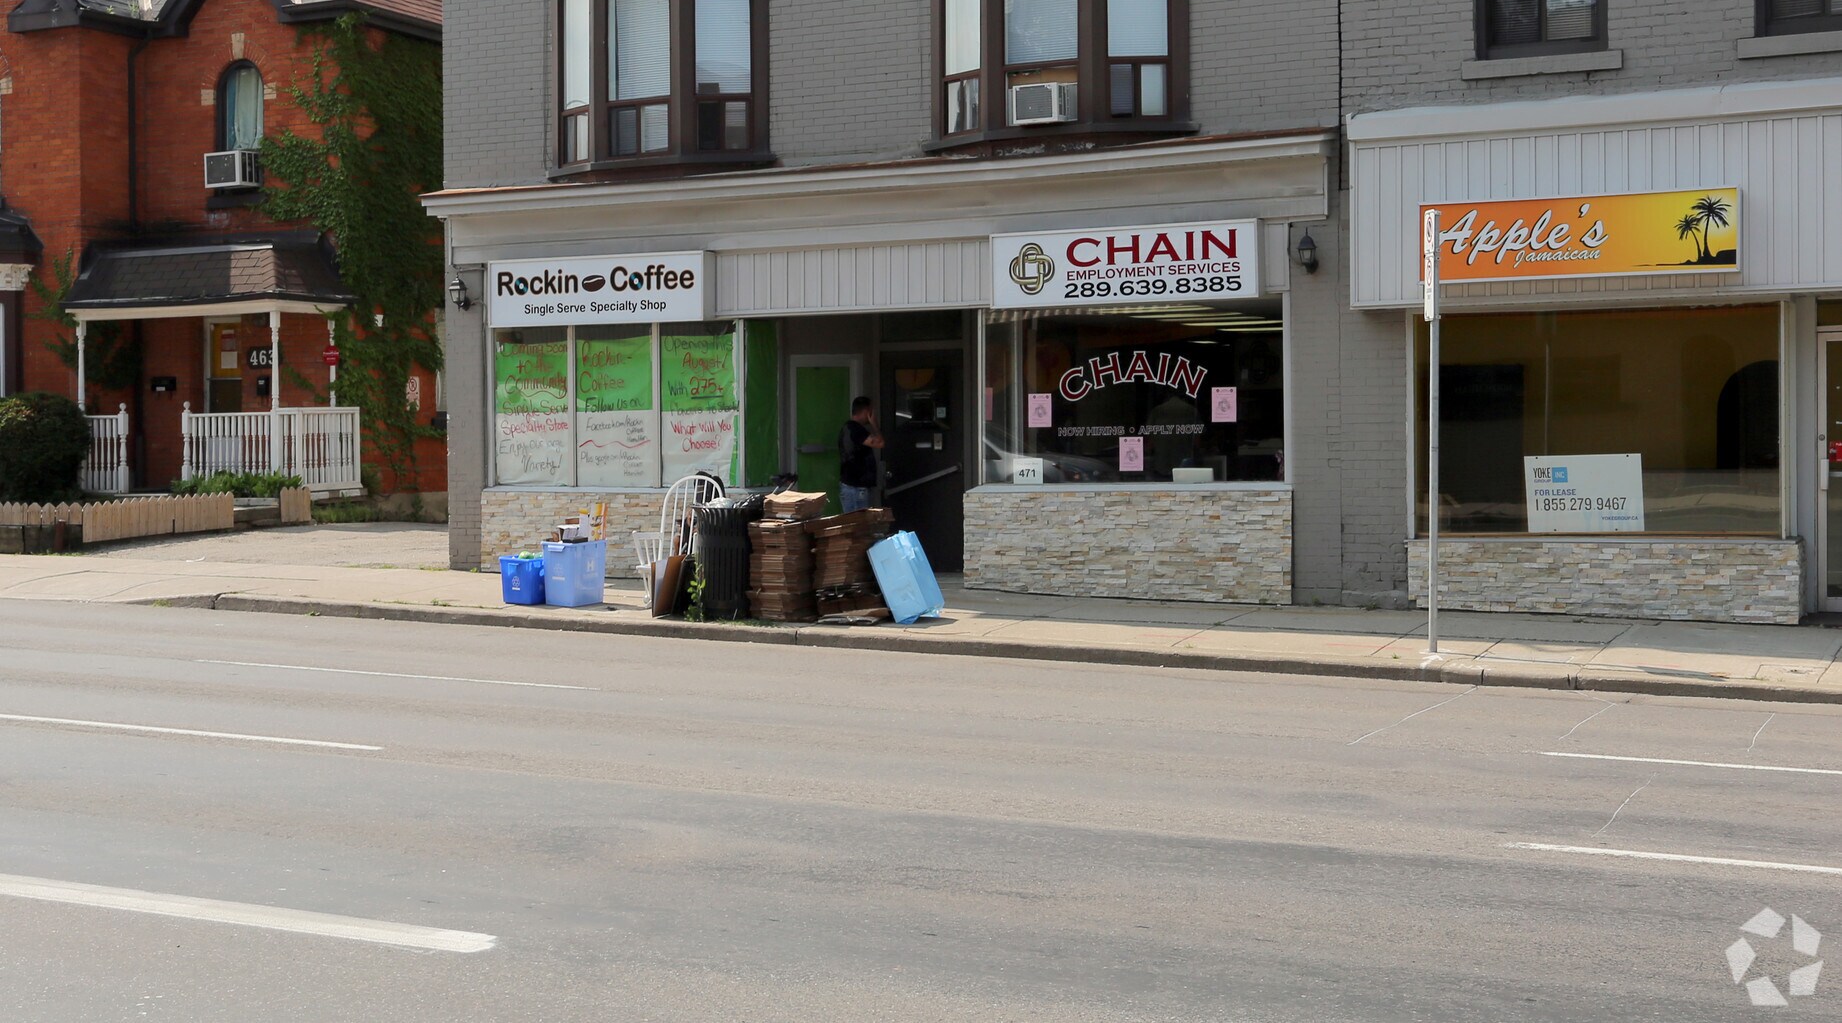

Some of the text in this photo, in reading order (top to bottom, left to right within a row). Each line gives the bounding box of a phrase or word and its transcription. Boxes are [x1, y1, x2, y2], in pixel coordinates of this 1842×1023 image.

[1439, 203, 1609, 265] Apple's
[1066, 228, 1238, 268] CHAIN
[1513, 247, 1601, 269] Jamaican
[1066, 261, 1241, 281] EMPLOYMENT SERVICES
[497, 264, 695, 297] Rockin Coffee
[1064, 275, 1242, 299] 289.639.8385
[524, 299, 667, 316] Single Serve Specialty Shop
[250, 350, 274, 366] 463
[1059, 350, 1208, 401] CHAIN
[501, 418, 569, 438] Specialty Store
[670, 419, 732, 435] What Will You
[1058, 424, 1204, 436] NOW HIRING APPLY NOW
[682, 434, 721, 452] Choose?
[1019, 469, 1036, 477] 471
[1533, 467, 1551, 479] YOKE
[1552, 488, 1576, 496] LEASE
[1535, 497, 1627, 511] 1.855.279.9467
